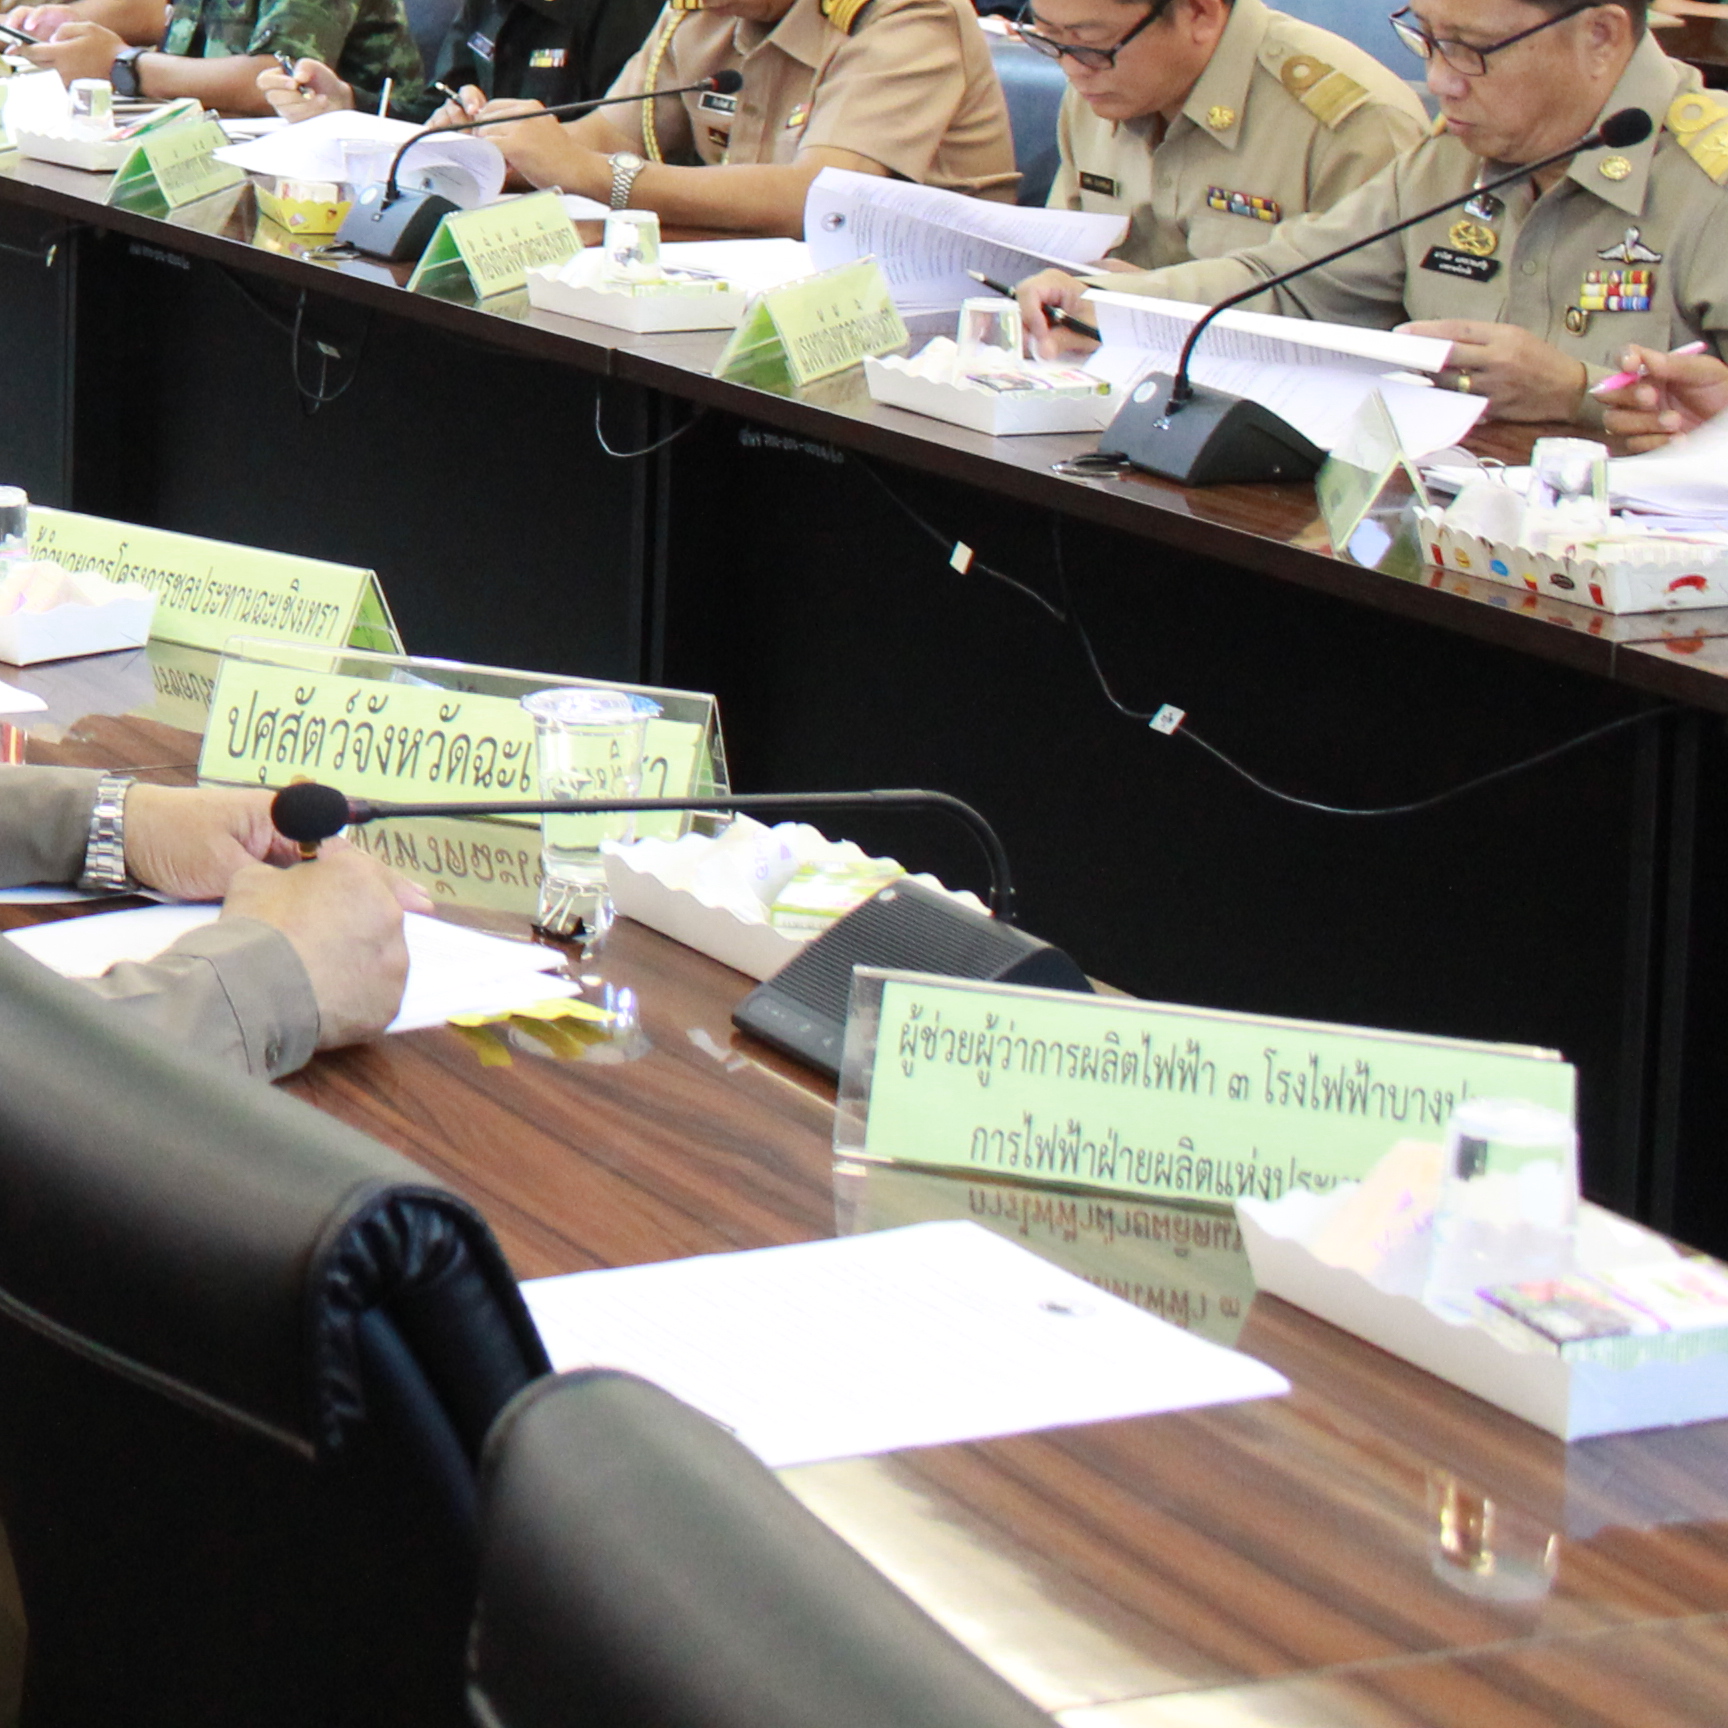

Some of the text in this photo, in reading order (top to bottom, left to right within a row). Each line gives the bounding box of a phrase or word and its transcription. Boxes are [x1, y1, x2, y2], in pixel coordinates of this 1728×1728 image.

[899, 1003, 1217, 1096] ผู้ช่วยผู้ว่าการผลิตไฟฟ้า
[1228, 1072, 1250, 1101] ๓
